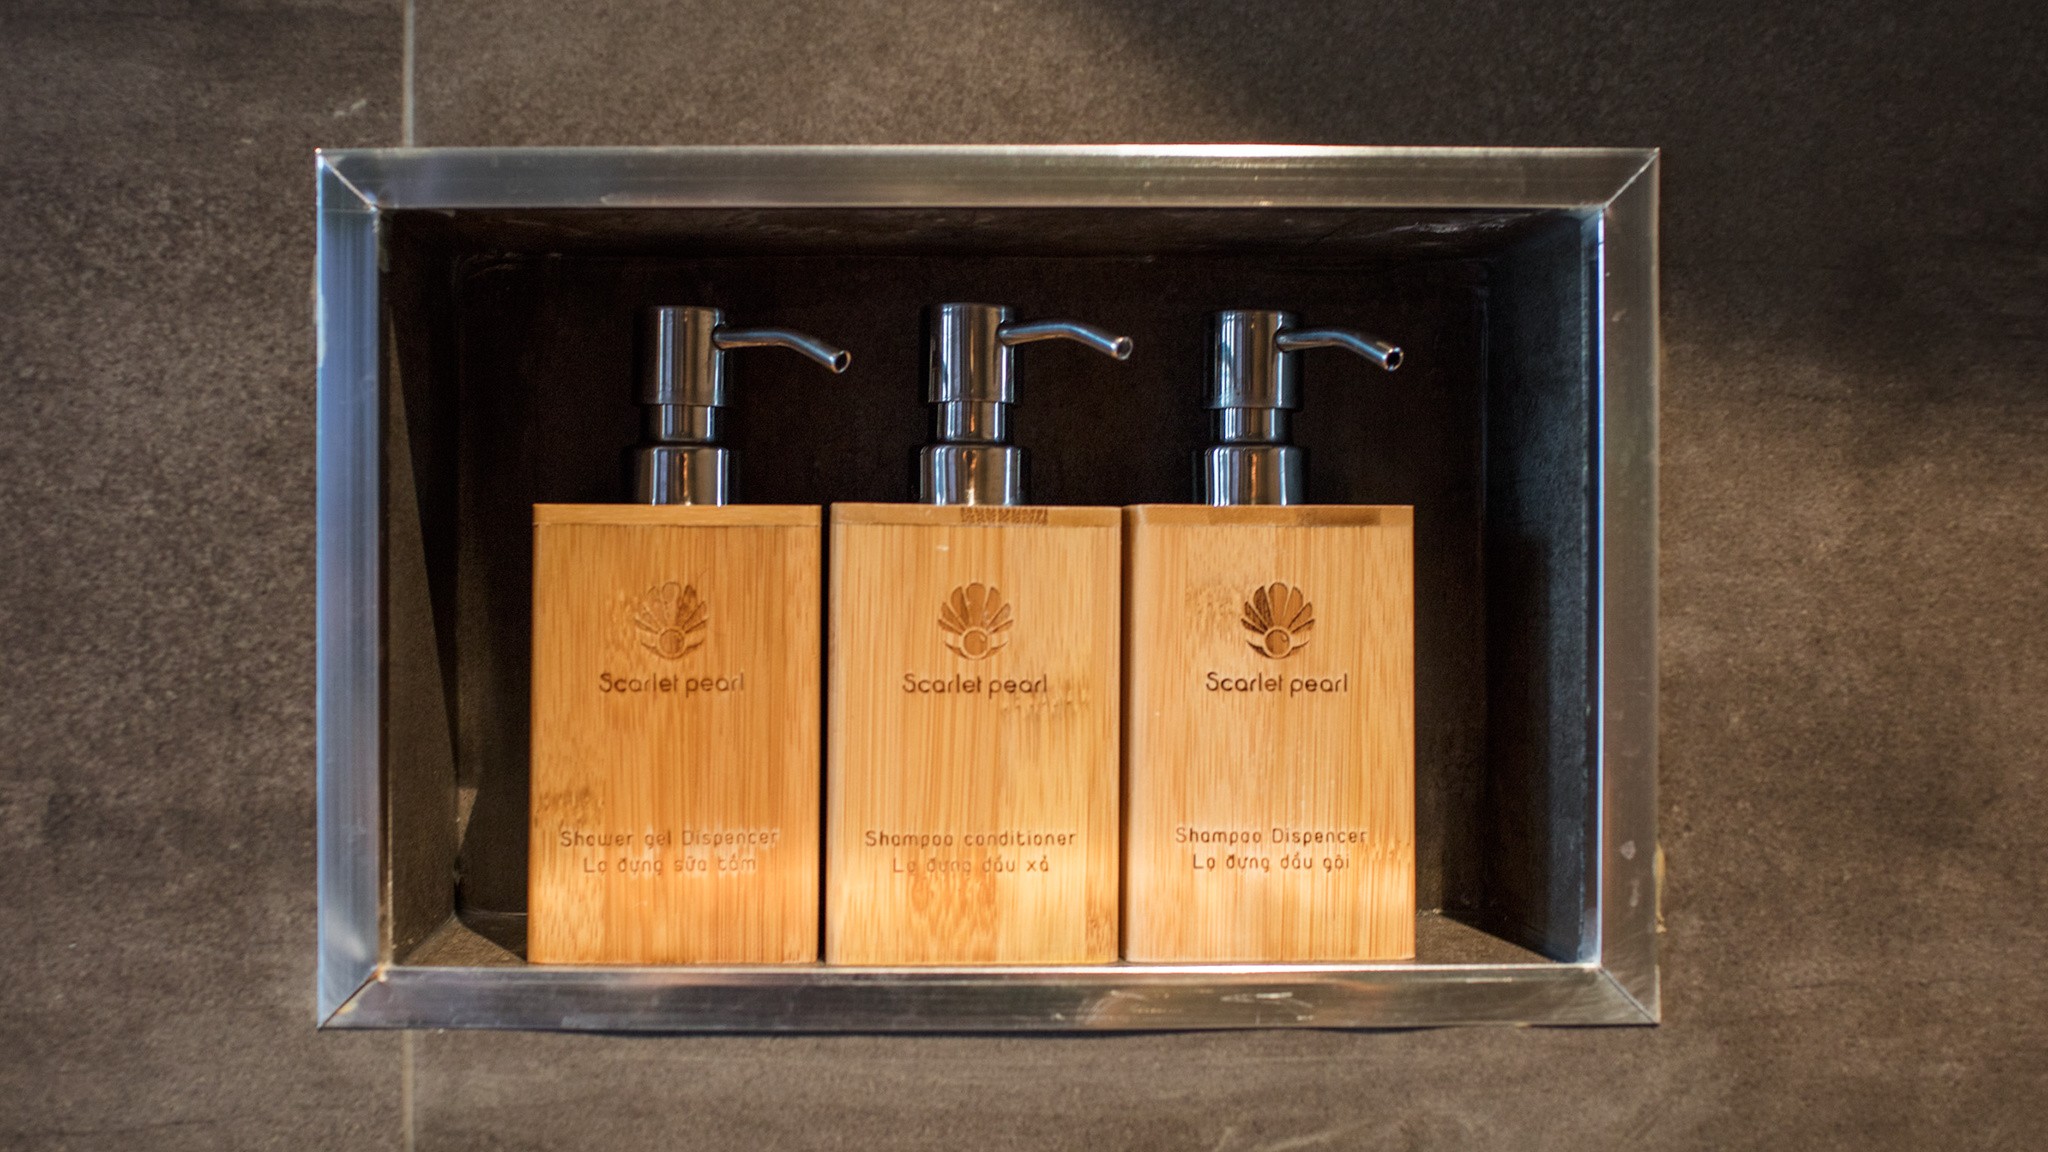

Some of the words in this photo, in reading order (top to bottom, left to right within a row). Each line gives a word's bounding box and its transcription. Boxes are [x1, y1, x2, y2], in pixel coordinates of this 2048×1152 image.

[599, 672, 678, 693] Scarlet
[685, 672, 744, 698] pearl
[902, 673, 981, 693] Scarlet
[989, 673, 1047, 699] pearl
[1206, 672, 1283, 692] Scarlet
[1290, 672, 1348, 698] pearl
[561, 830, 633, 847] Shower
[645, 830, 671, 849] gel
[682, 829, 779, 848] Dispencer
[865, 830, 953, 849] Shampoo
[964, 830, 1076, 847] conditioner
[1175, 827, 1262, 846] Shampoo
[1272, 827, 1367, 847] Dispencer
[1193, 854, 1215, 872] Lọ
